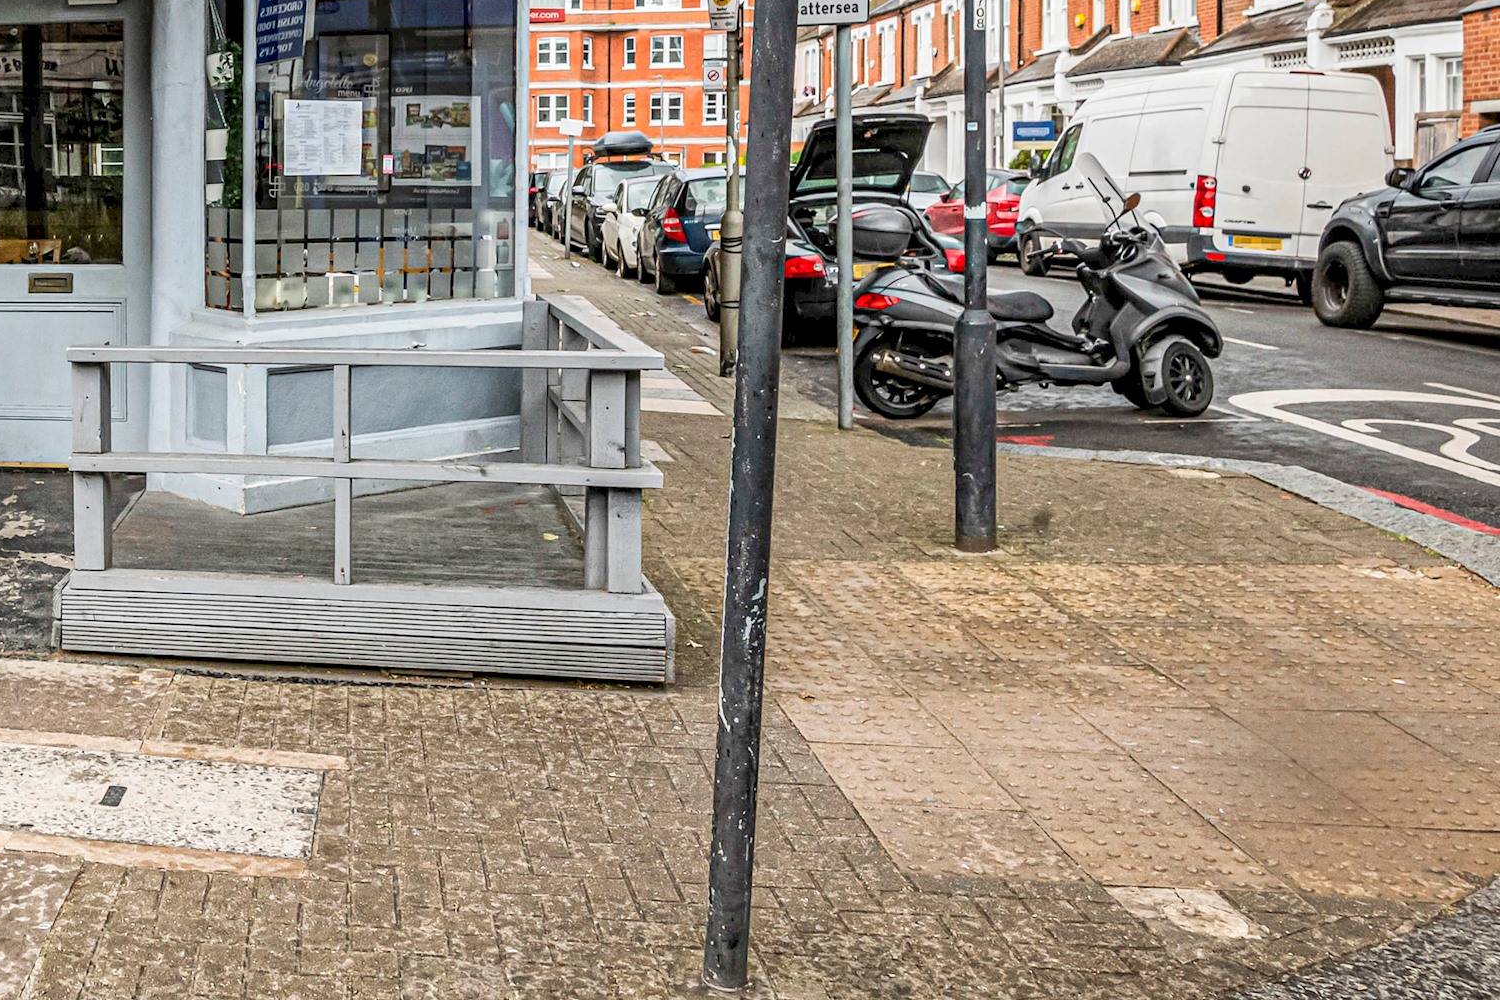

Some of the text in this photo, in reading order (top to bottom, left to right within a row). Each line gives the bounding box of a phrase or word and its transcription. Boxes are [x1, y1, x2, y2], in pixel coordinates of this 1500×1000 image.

[798, 2, 859, 16] attersea
[530, 11, 560, 21] er.com
[337, 89, 361, 98] menu
